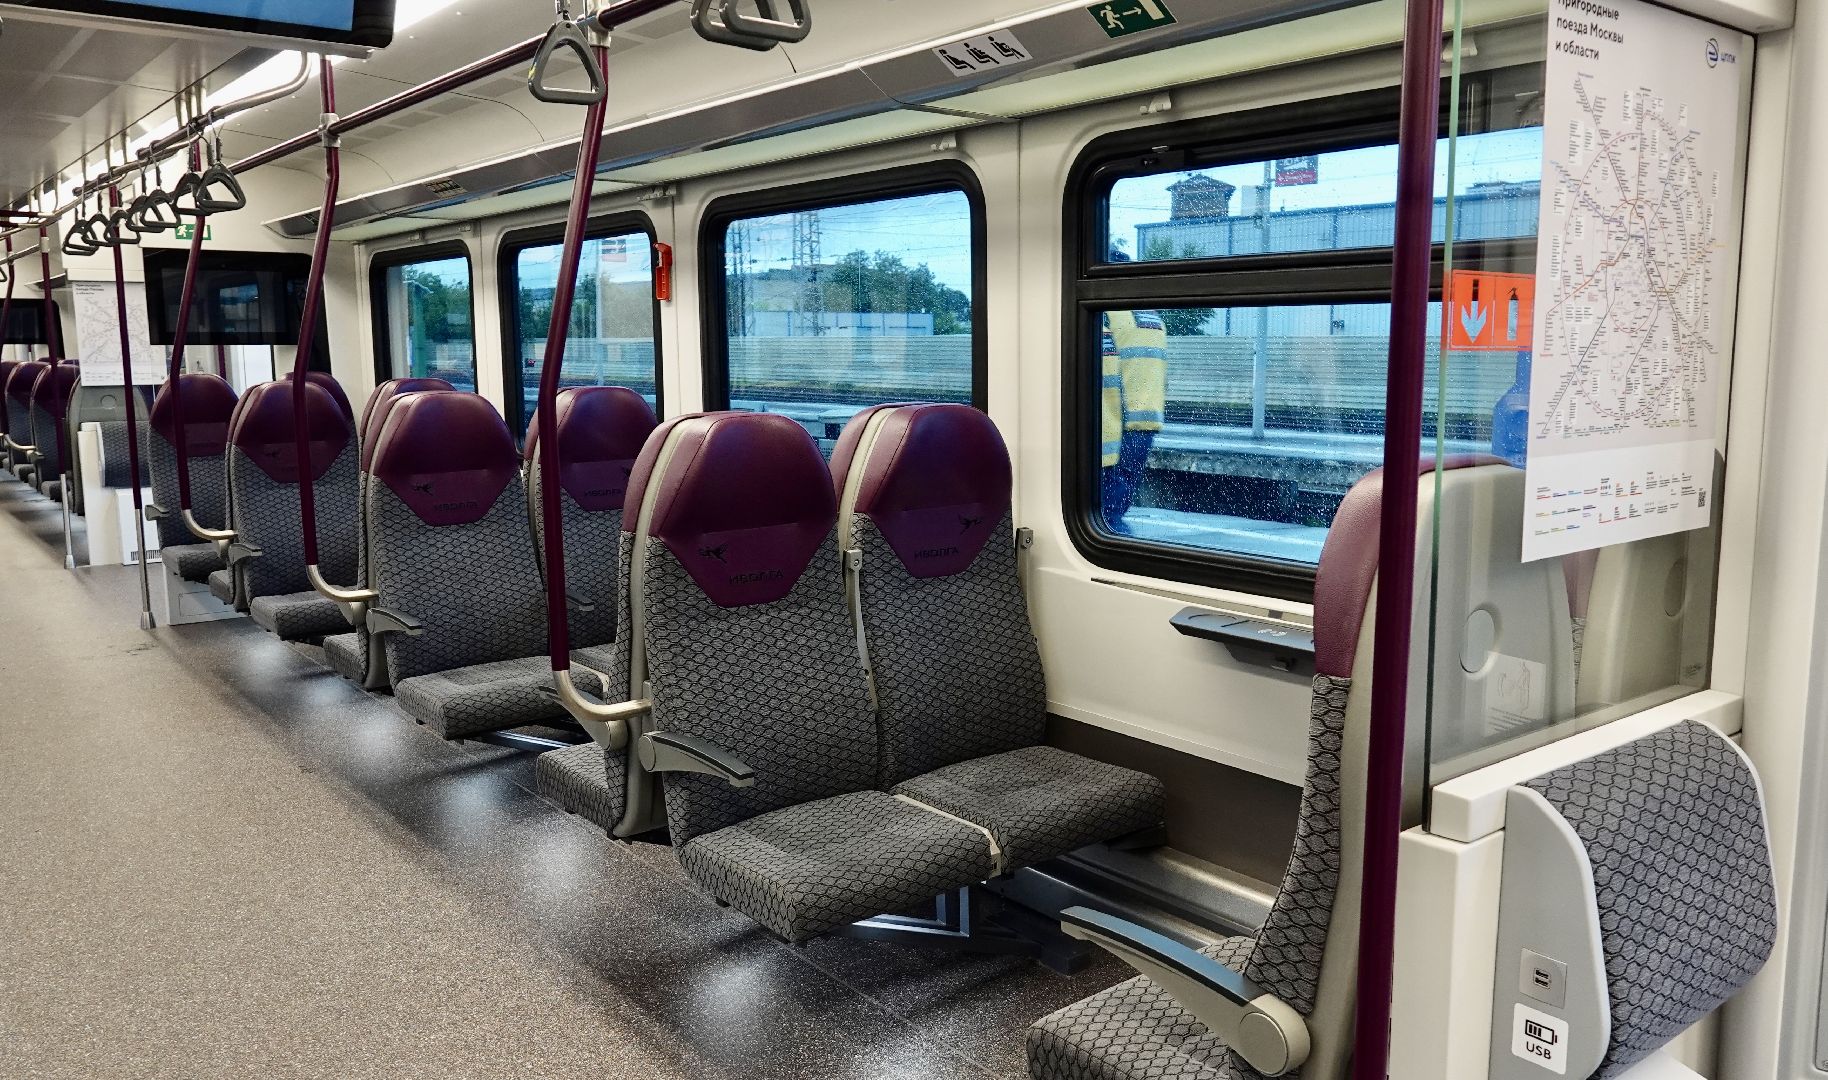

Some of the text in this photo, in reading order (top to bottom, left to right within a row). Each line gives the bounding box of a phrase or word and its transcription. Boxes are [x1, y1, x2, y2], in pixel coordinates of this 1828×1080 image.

[1557, 17, 1624, 44] поезда Москвы
[1555, 40, 1599, 60] и области
[1526, 1041, 1551, 1059] USB
